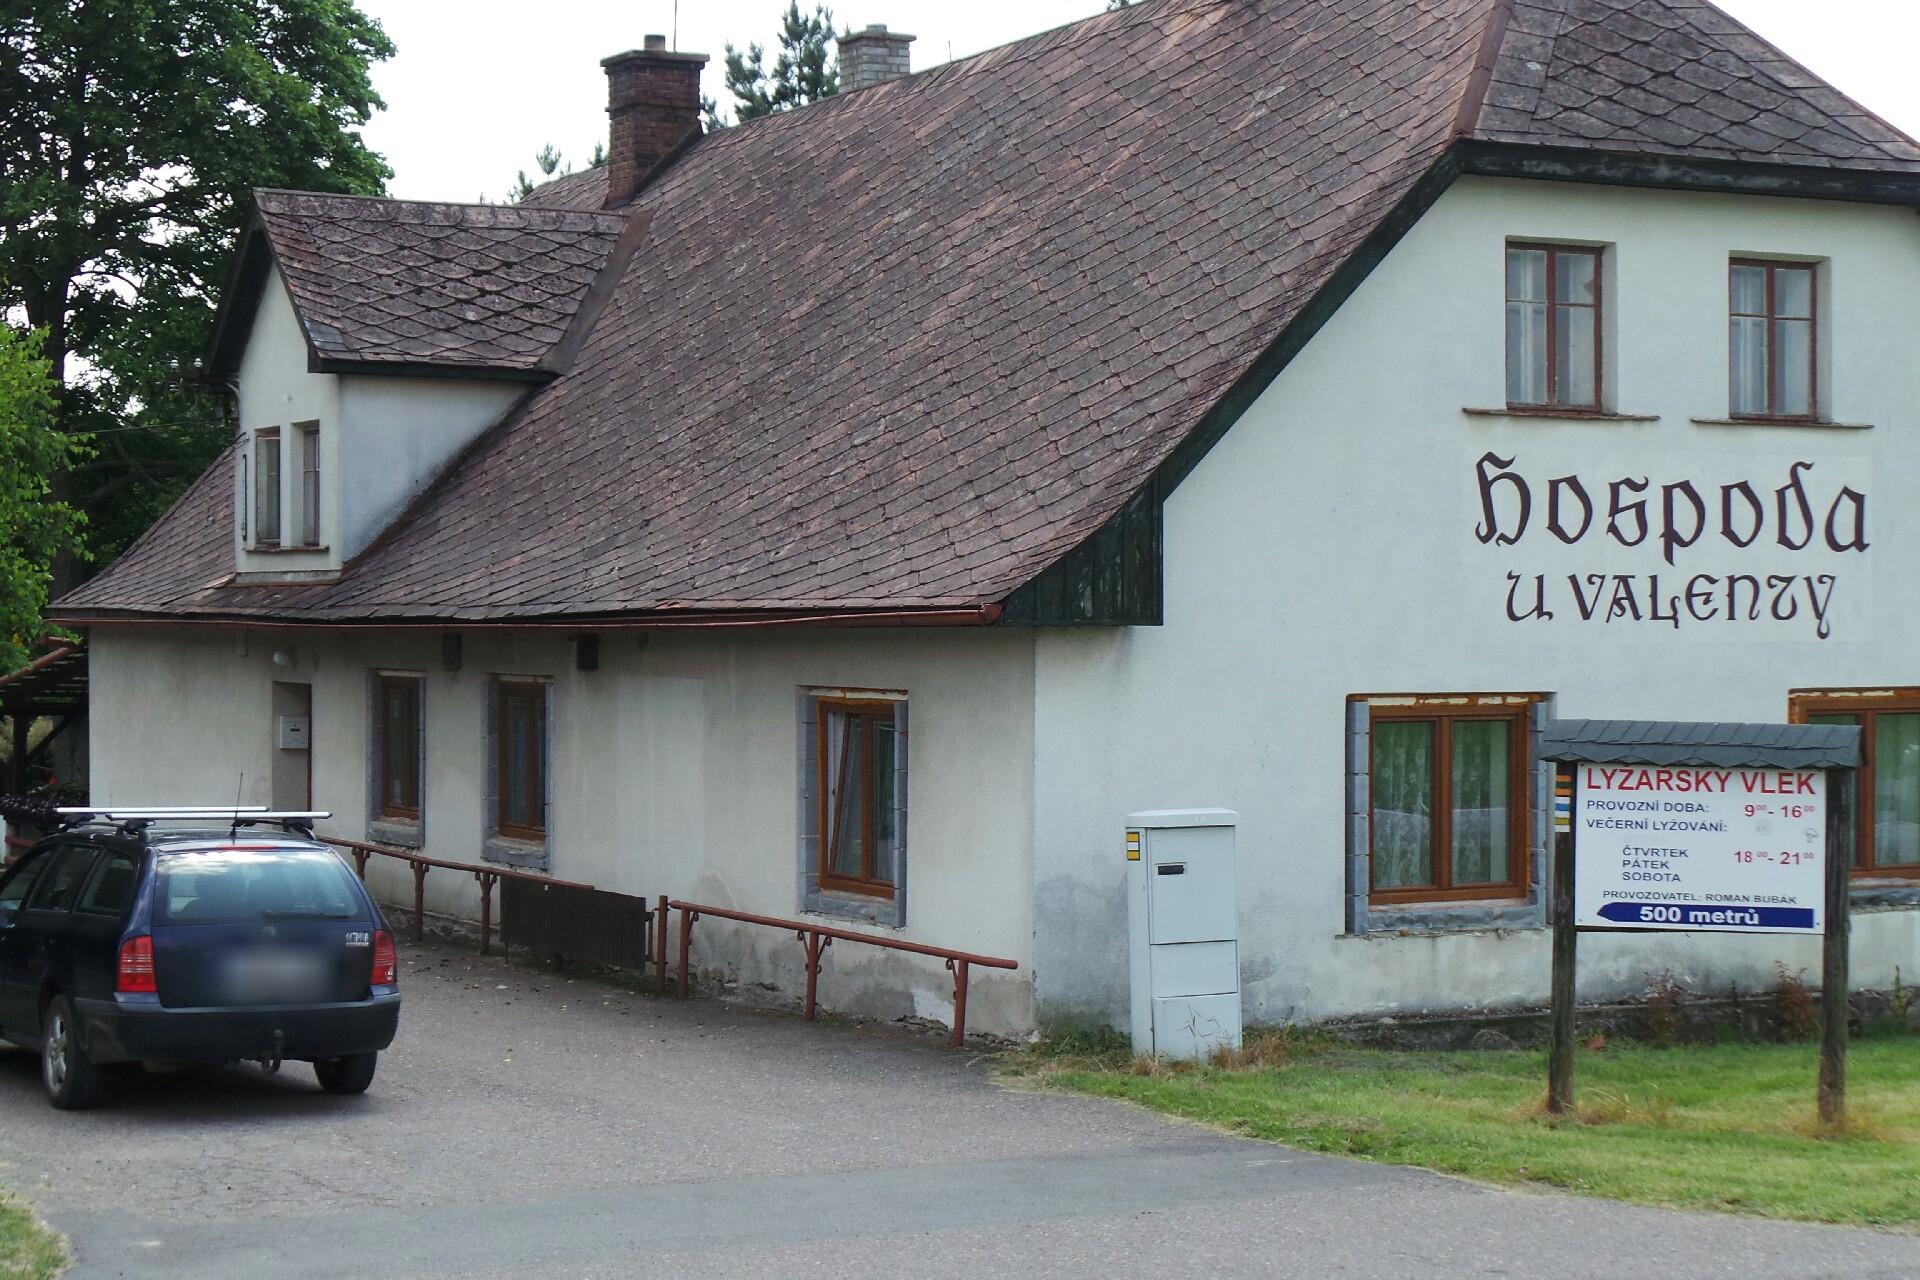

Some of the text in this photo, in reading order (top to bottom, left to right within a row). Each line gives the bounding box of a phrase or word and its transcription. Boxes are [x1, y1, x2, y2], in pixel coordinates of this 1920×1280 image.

[1475, 452, 1870, 567] Hospoda
[1506, 570, 1554, 622] U
[1740, 771, 1816, 794] VLEK
[1586, 800, 1659, 812] PROVOZNÍ
[1664, 802, 1710, 813] DOBA:
[1586, 816, 1648, 829] VEČERNÍ
[1622, 845, 1688, 857] ČTVRTEK
[1622, 858, 1670, 870] PÁTEK
[1622, 872, 1681, 882] SOBOTA
[1705, 893, 1750, 902] ROMAN
[1640, 906, 1759, 924] 500 metrů
